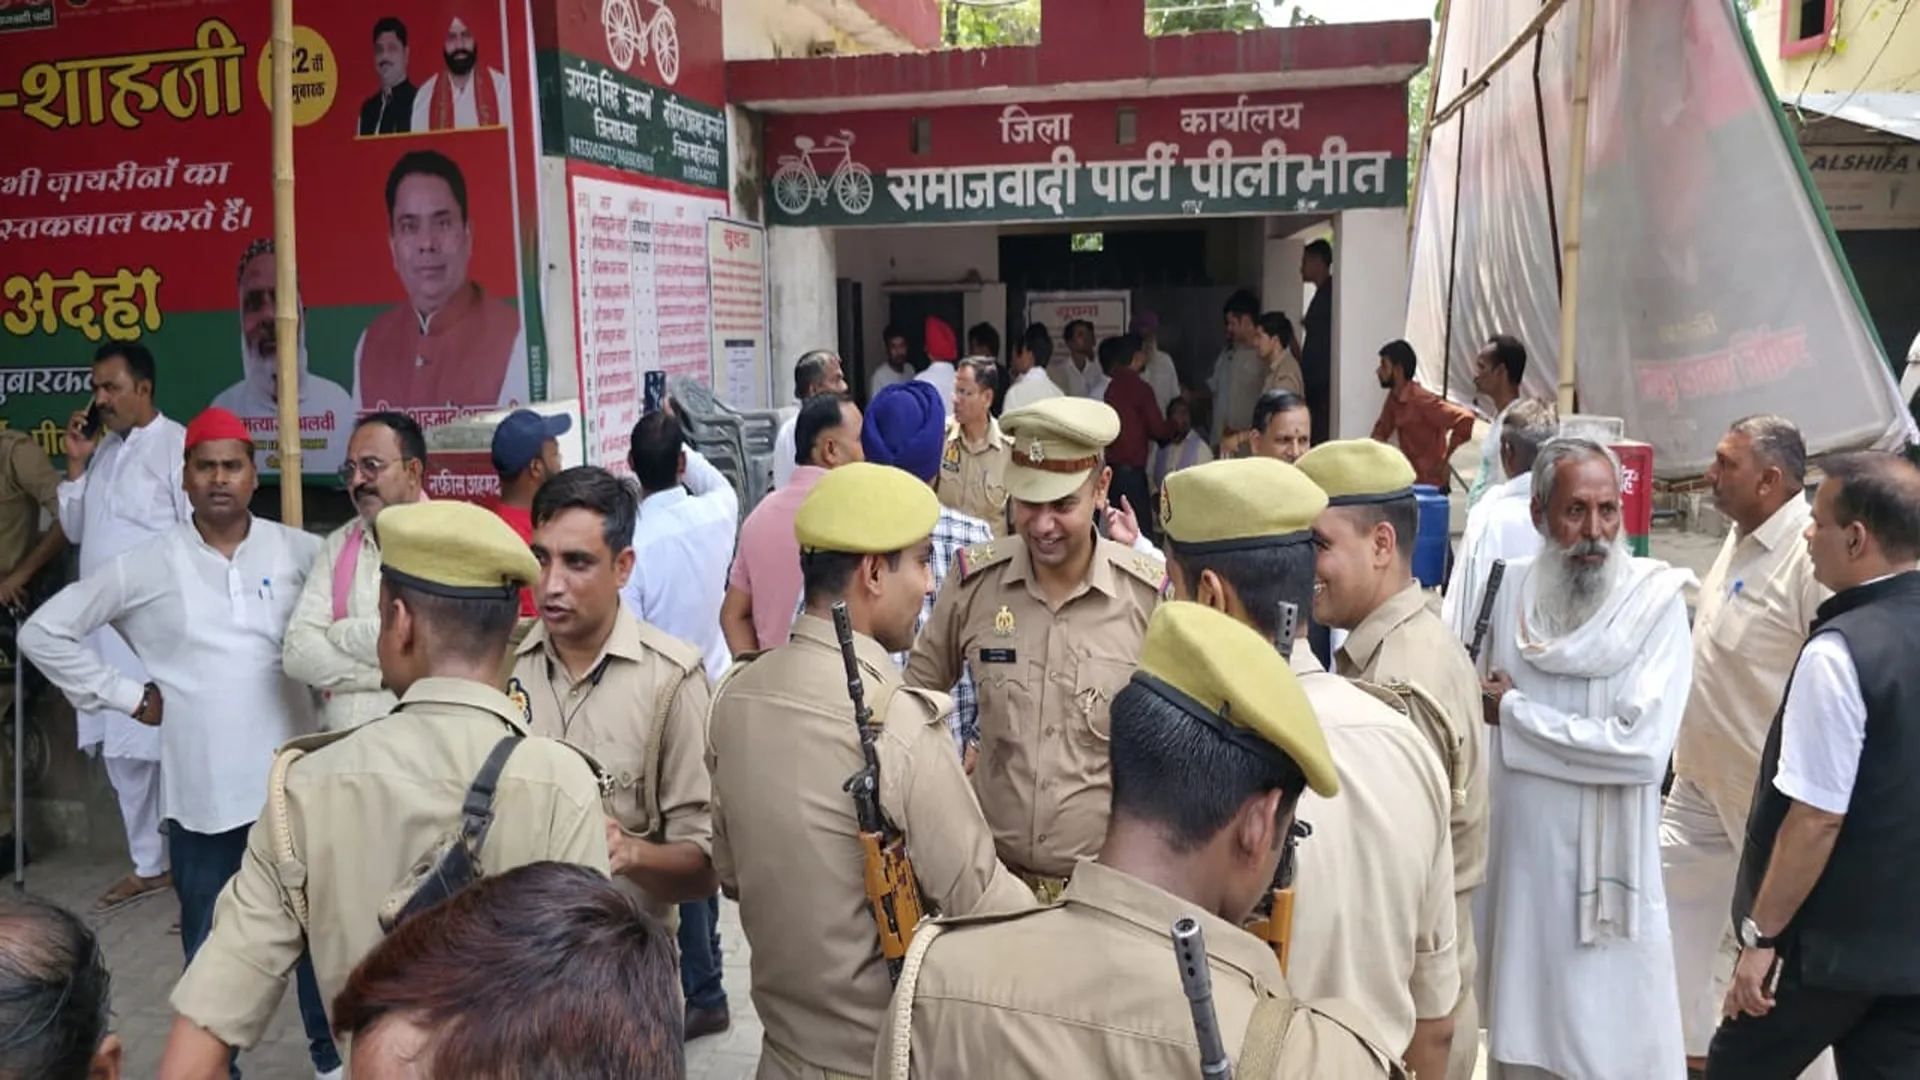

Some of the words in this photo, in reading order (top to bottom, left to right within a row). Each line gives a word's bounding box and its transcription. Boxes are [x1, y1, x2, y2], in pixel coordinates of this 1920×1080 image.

[998, 104, 1074, 144] जिला
[1180, 95, 1304, 134] कार्यालय
[183, 162, 233, 185] का
[886, 145, 1082, 215] समाजवादी
[1085, 141, 1180, 202] पार्टी
[1183, 136, 1392, 199] पीलीभीत
[1809, 154, 1909, 172] ALSHIFA
[140, 200, 216, 233] करते
[4, 266, 162, 342] अदहा
